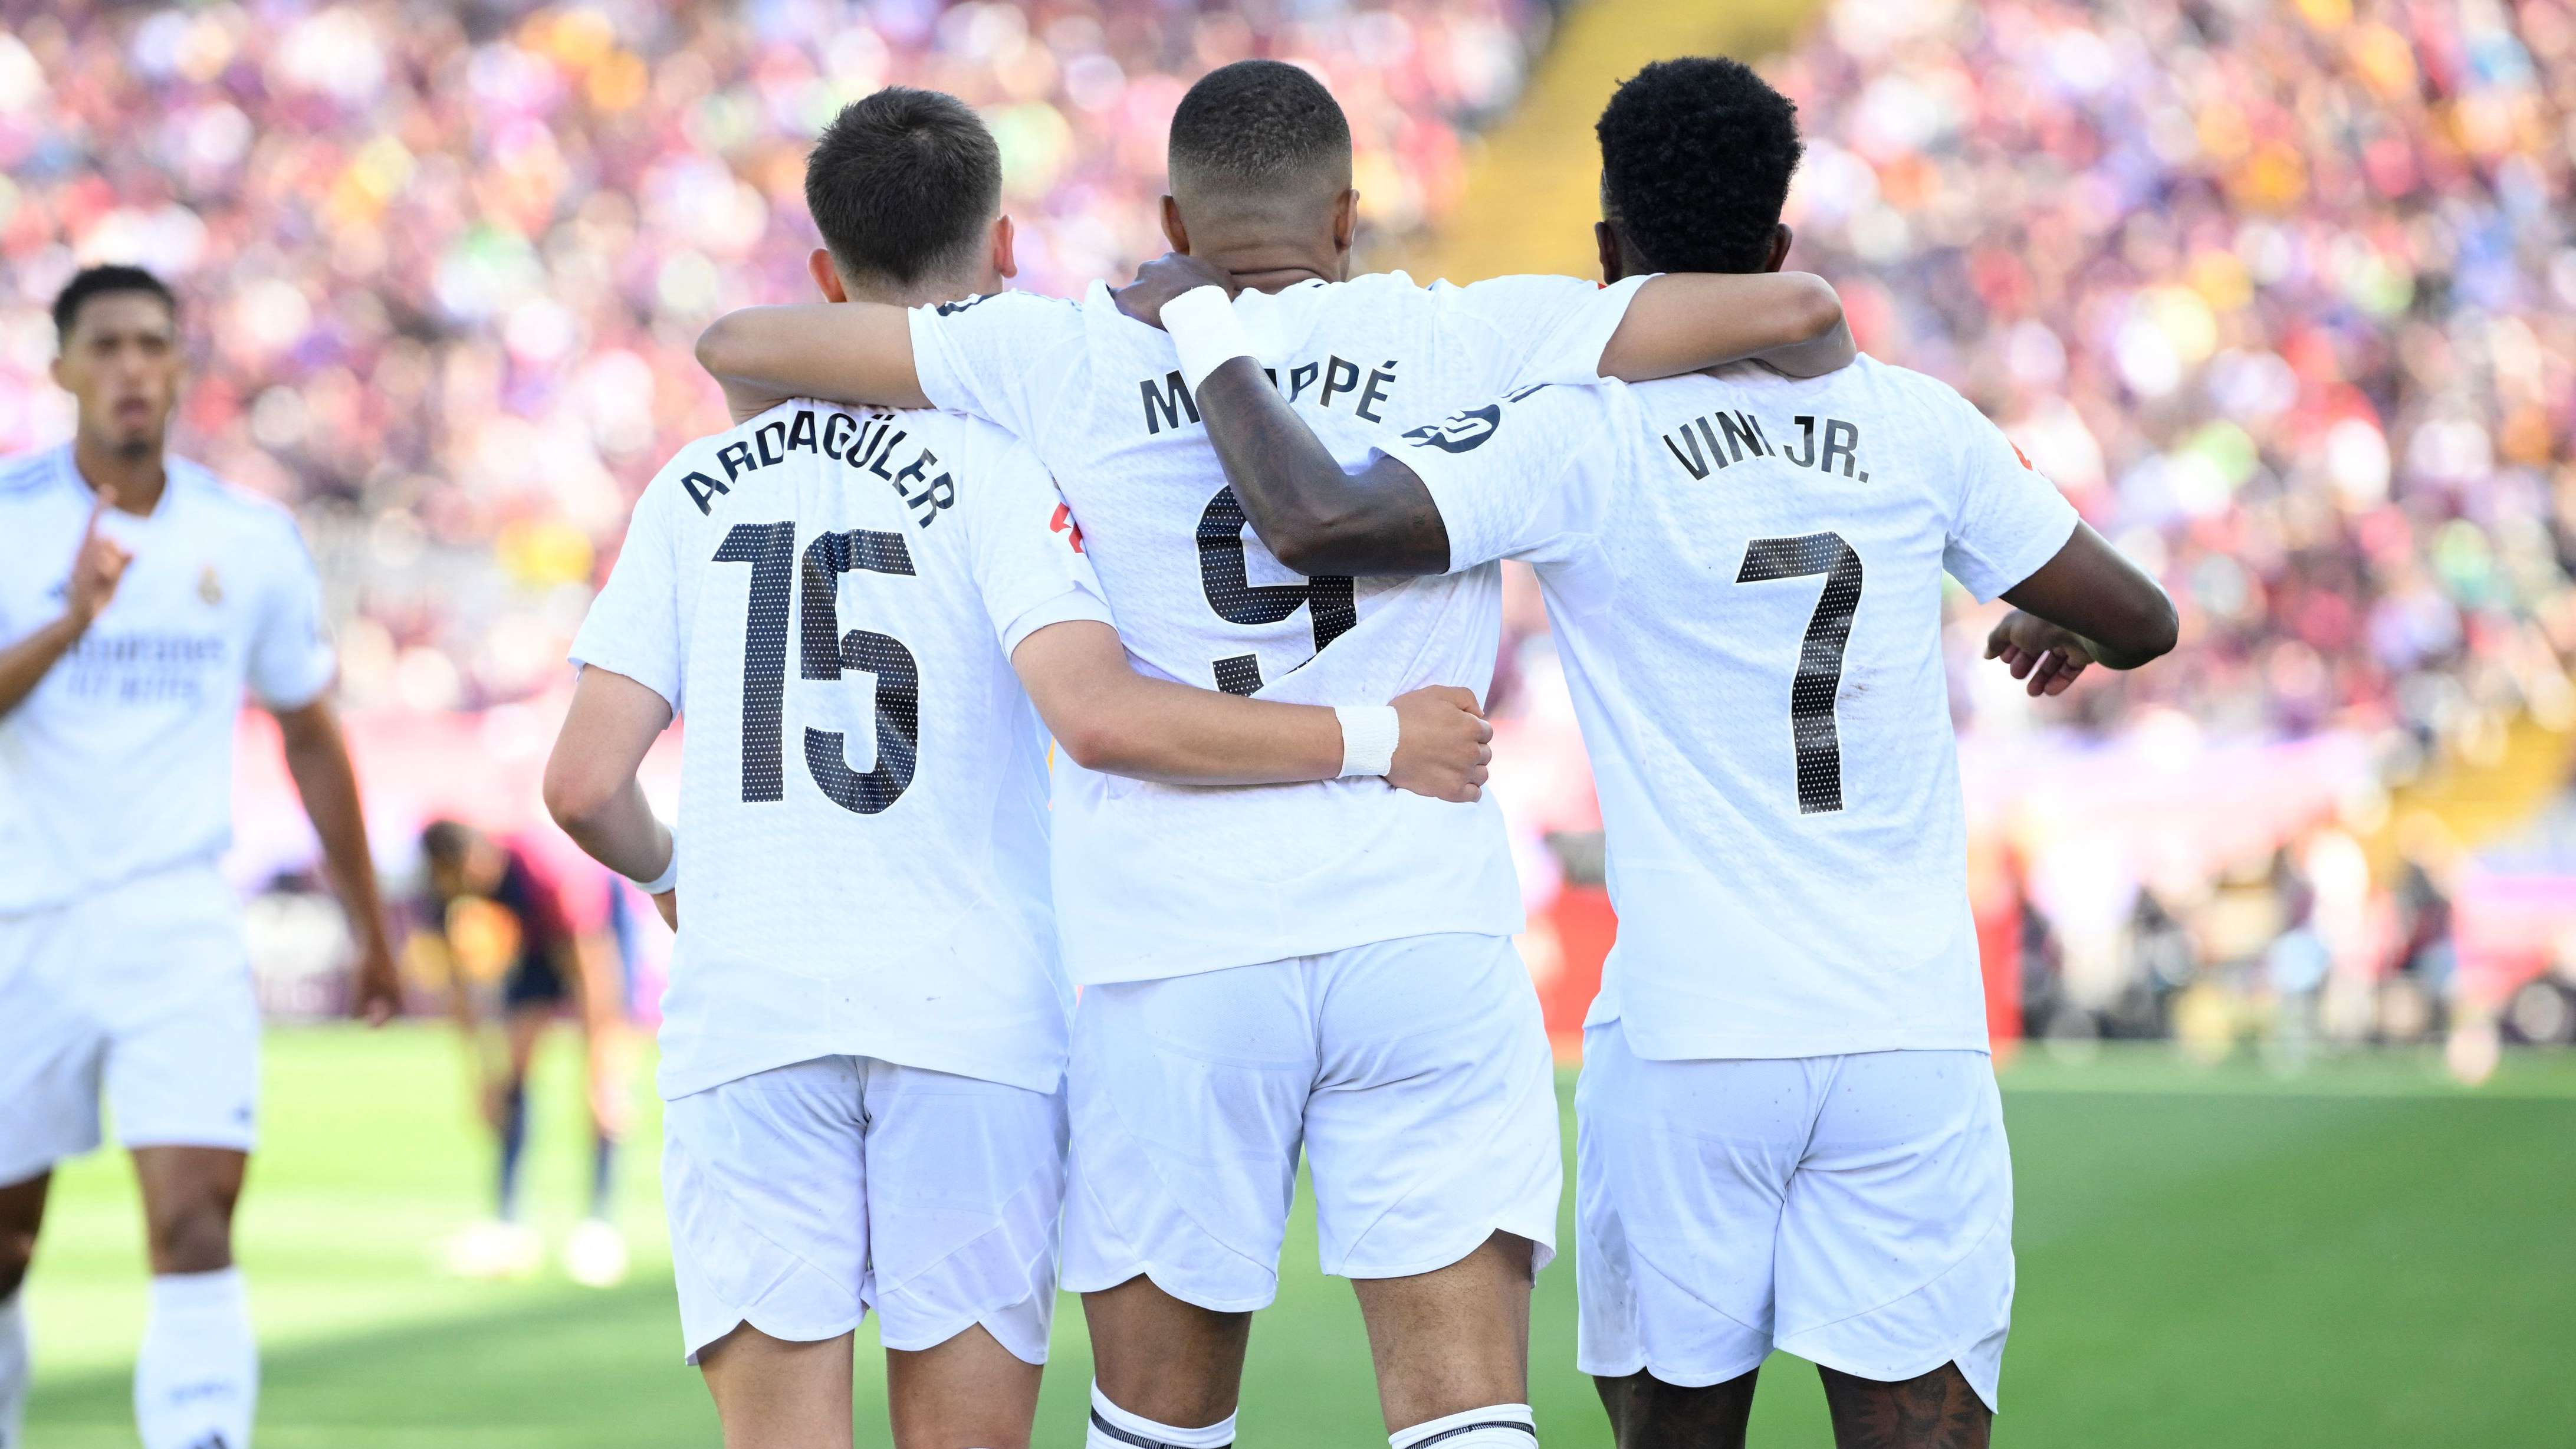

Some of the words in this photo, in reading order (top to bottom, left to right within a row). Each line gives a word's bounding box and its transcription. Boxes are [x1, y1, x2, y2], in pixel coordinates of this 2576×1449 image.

[1139, 354, 1398, 435] MPPÉ
[1662, 409, 1776, 481] VINI
[1783, 415, 1869, 484] JR.
[711, 520, 918, 814] 15
[1196, 484, 1357, 698] 9
[1735, 531, 1863, 814] 7
